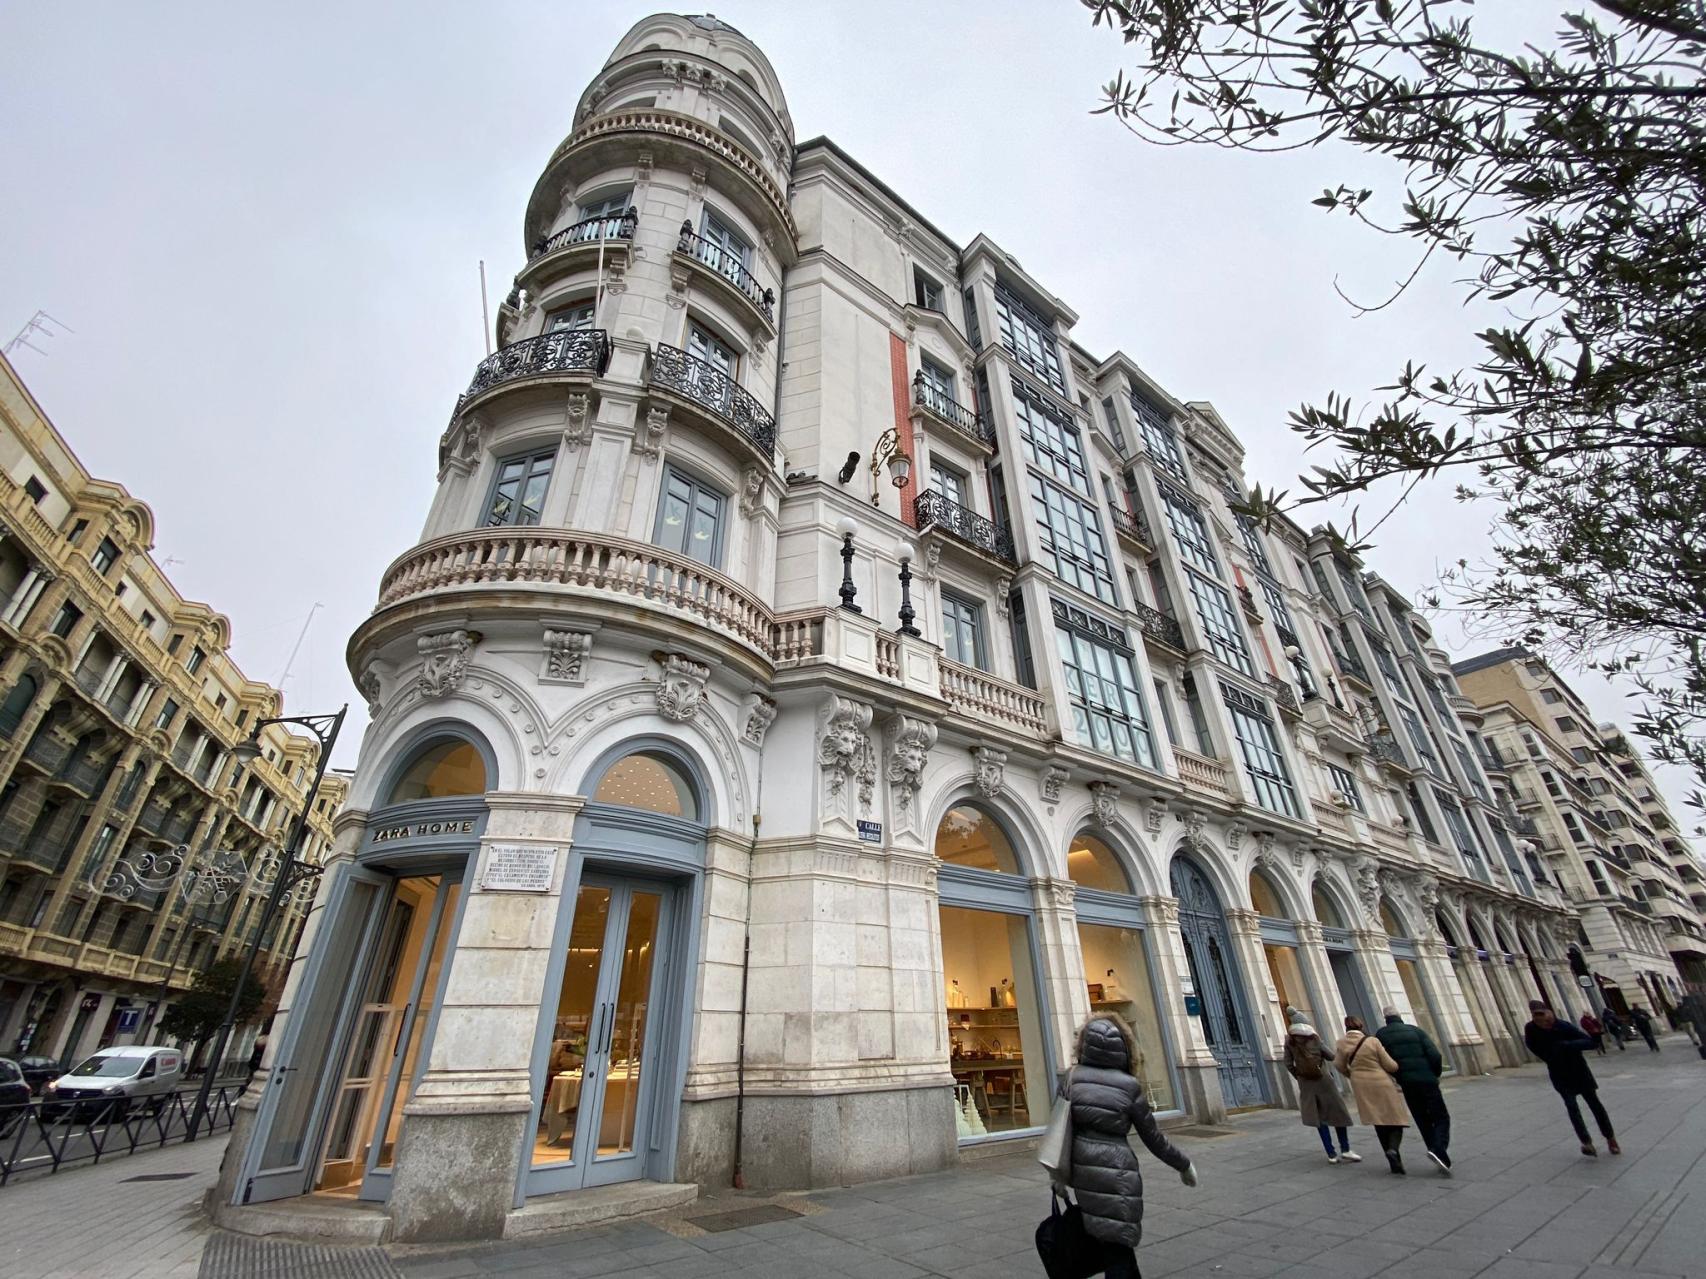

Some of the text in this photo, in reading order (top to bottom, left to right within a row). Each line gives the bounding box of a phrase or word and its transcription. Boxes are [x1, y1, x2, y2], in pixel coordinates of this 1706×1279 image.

[1072, 708, 1148, 754] 2000
[373, 821, 473, 841] ZARA HOME
[865, 822, 880, 831] CALLE
[125, 1010, 138, 1025] T
